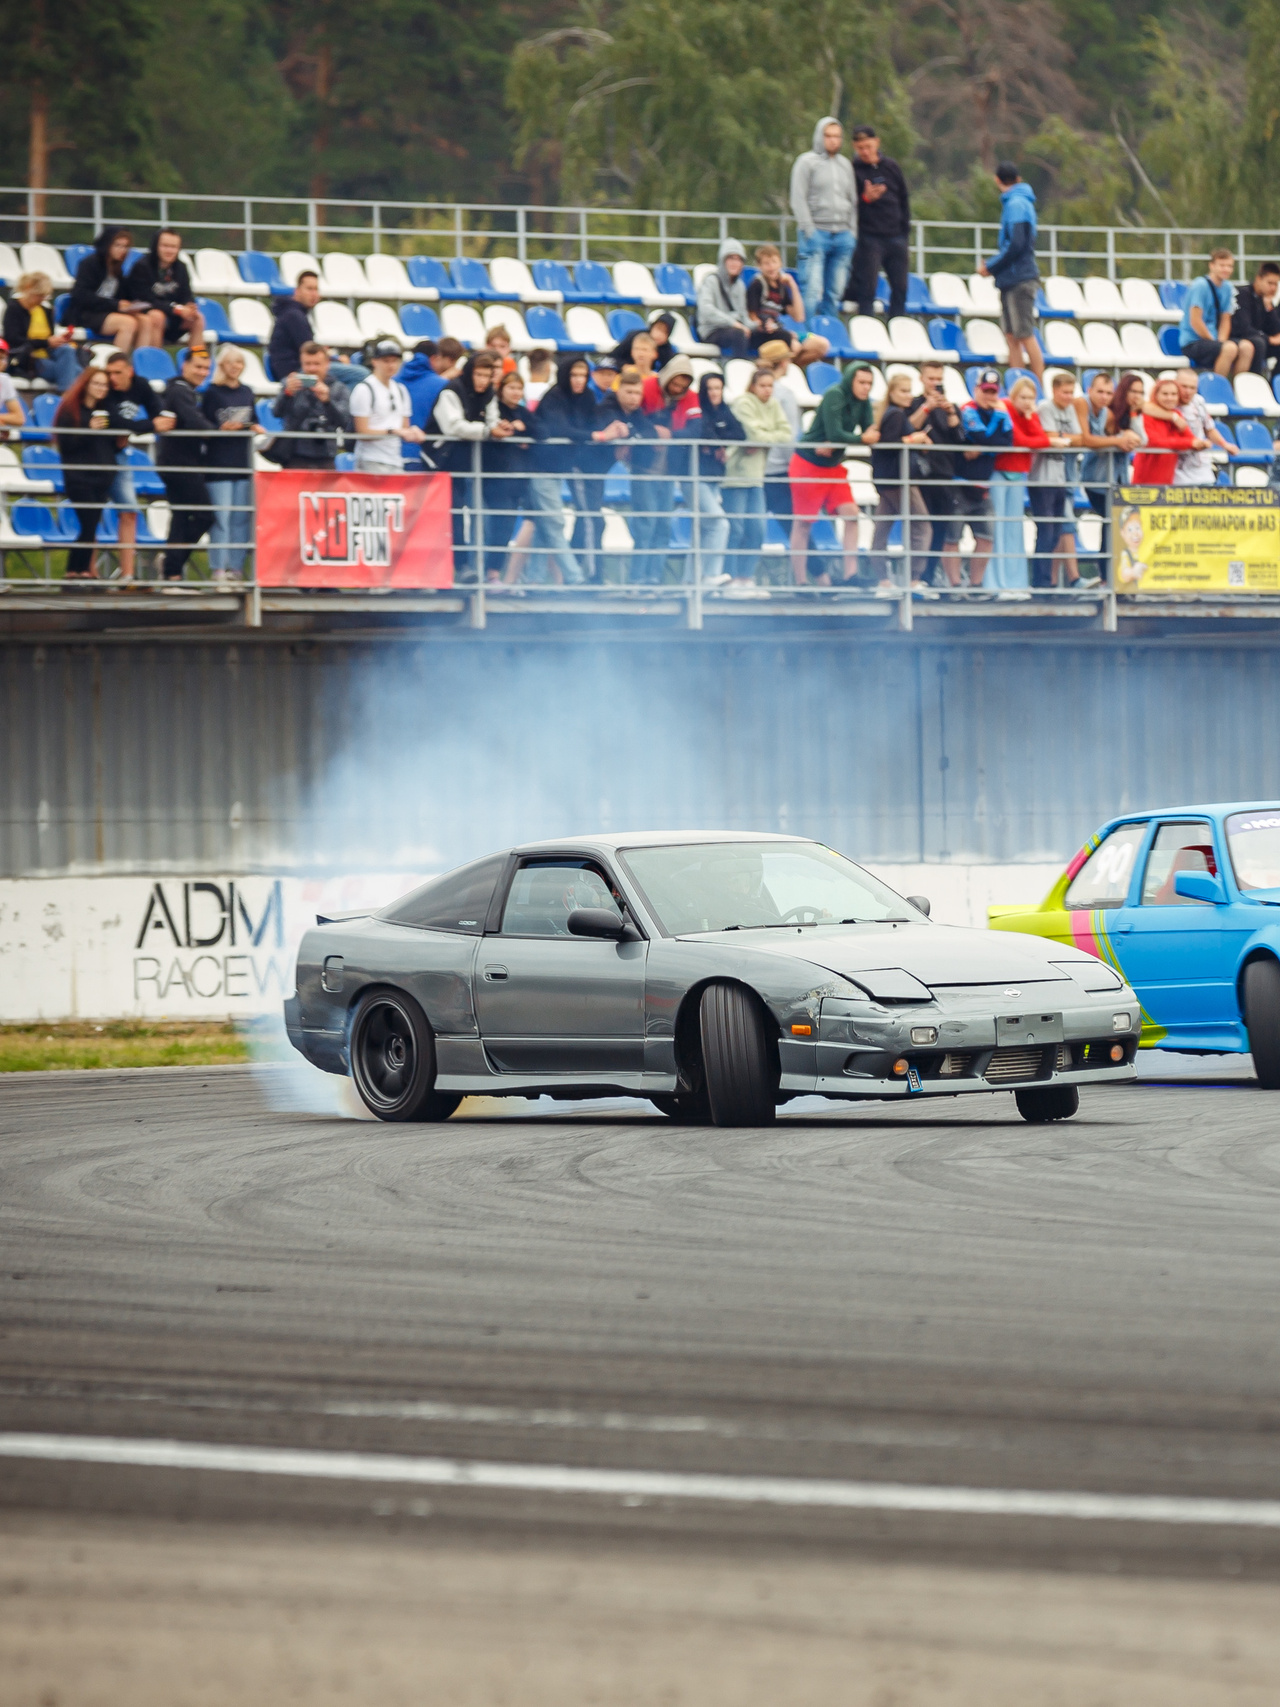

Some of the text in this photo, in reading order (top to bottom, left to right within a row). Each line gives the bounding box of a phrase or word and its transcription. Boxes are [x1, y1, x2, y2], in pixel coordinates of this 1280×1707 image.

[351, 496, 403, 528] DRIFT
[1165, 488, 1273, 504] АВТОЗАПЧАСТИ
[302, 494, 349, 562] NO
[1150, 514, 1167, 530] ВСЕ
[1170, 514, 1189, 531] ДЛЯ
[1192, 514, 1246, 531] ИНОМАРОК
[1257, 514, 1276, 531] ВАЗ
[352, 531, 389, 561] FUN
[135, 880, 283, 949] ADM
[133, 954, 295, 1000] RACEW
